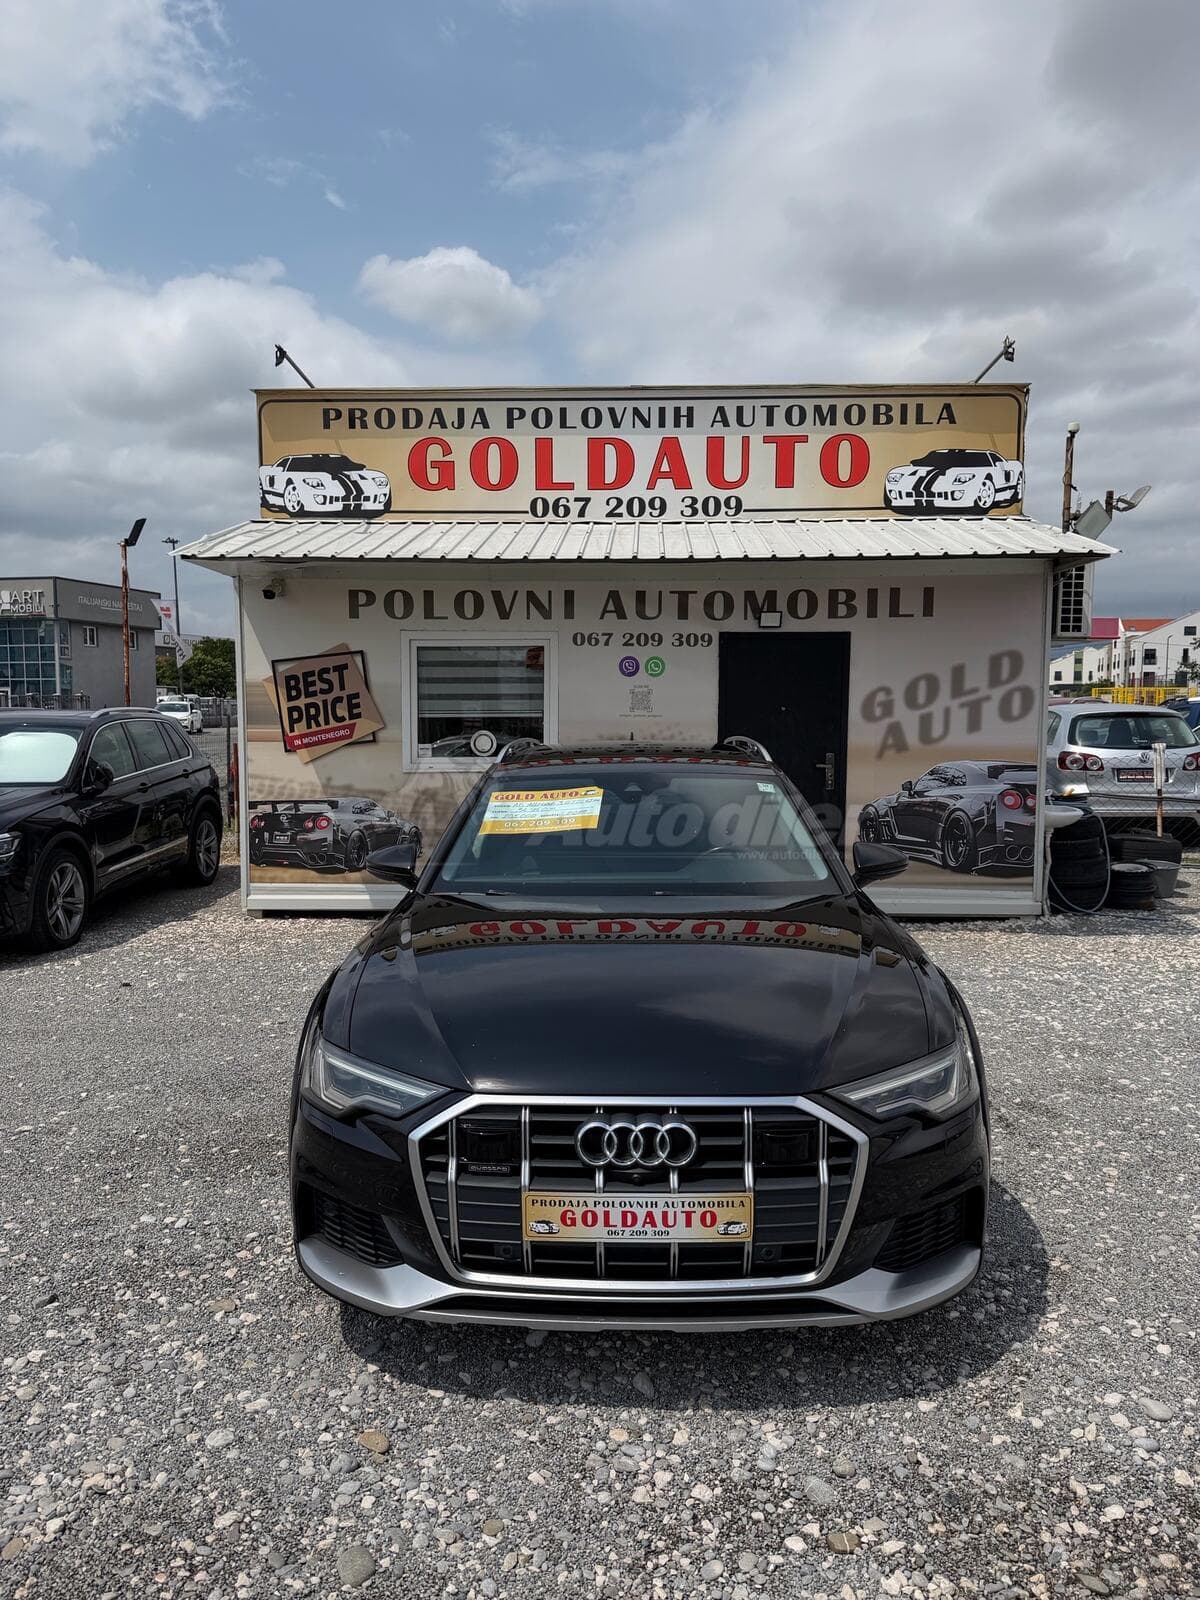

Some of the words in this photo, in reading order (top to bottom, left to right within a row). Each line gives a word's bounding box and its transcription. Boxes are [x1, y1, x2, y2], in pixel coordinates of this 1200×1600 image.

[322, 407, 491, 430] PRODAJA
[506, 406, 695, 430] POLOVNIH
[710, 402, 957, 428] AUTOMOBILA
[407, 433, 871, 492] GOLDAUTO
[529, 497, 592, 519] 067
[605, 496, 668, 518] 209
[680, 495, 743, 518] 309
[347, 588, 576, 621] POLOVNI
[599, 586, 935, 621] AUTOMOBILI
[572, 632, 614, 647] 067
[621, 632, 664, 647] 209
[671, 632, 713, 648] 309
[284, 663, 349, 703] BEST
[860, 648, 1025, 724] GOLD
[286, 692, 362, 734] PRICE
[875, 684, 1036, 761] AUTO
[293, 738, 302, 747] IN
[302, 729, 351, 744] MONTENEGRO
[494, 793, 536, 801] GOLD
[540, 790, 580, 800] AUTO
[531, 1198, 589, 1208] PRODAJA
[593, 1199, 658, 1209] POLOVNIH
[662, 1199, 746, 1209] AUTOMOBILA
[559, 1208, 719, 1229] GOLDAUTO
